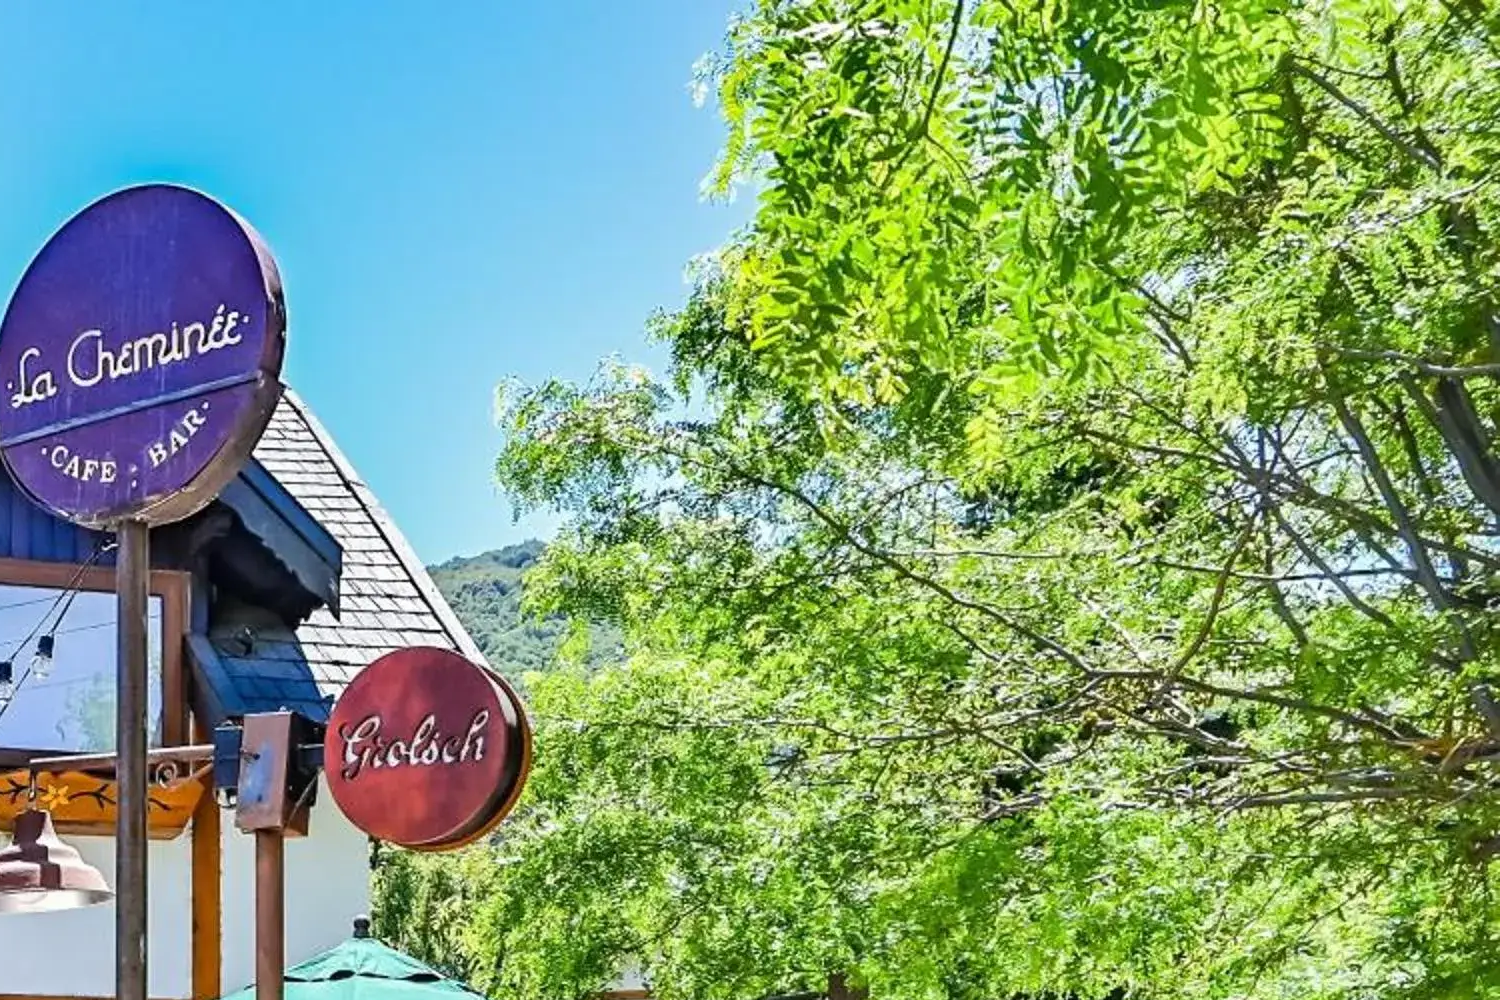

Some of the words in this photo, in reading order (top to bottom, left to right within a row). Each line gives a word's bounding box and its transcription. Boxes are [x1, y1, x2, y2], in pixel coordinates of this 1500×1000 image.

[11, 348, 57, 408] La
[67, 304, 242, 387] Cheminée
[148, 408, 206, 468] BAR
[340, 709, 489, 781] Grolsch
